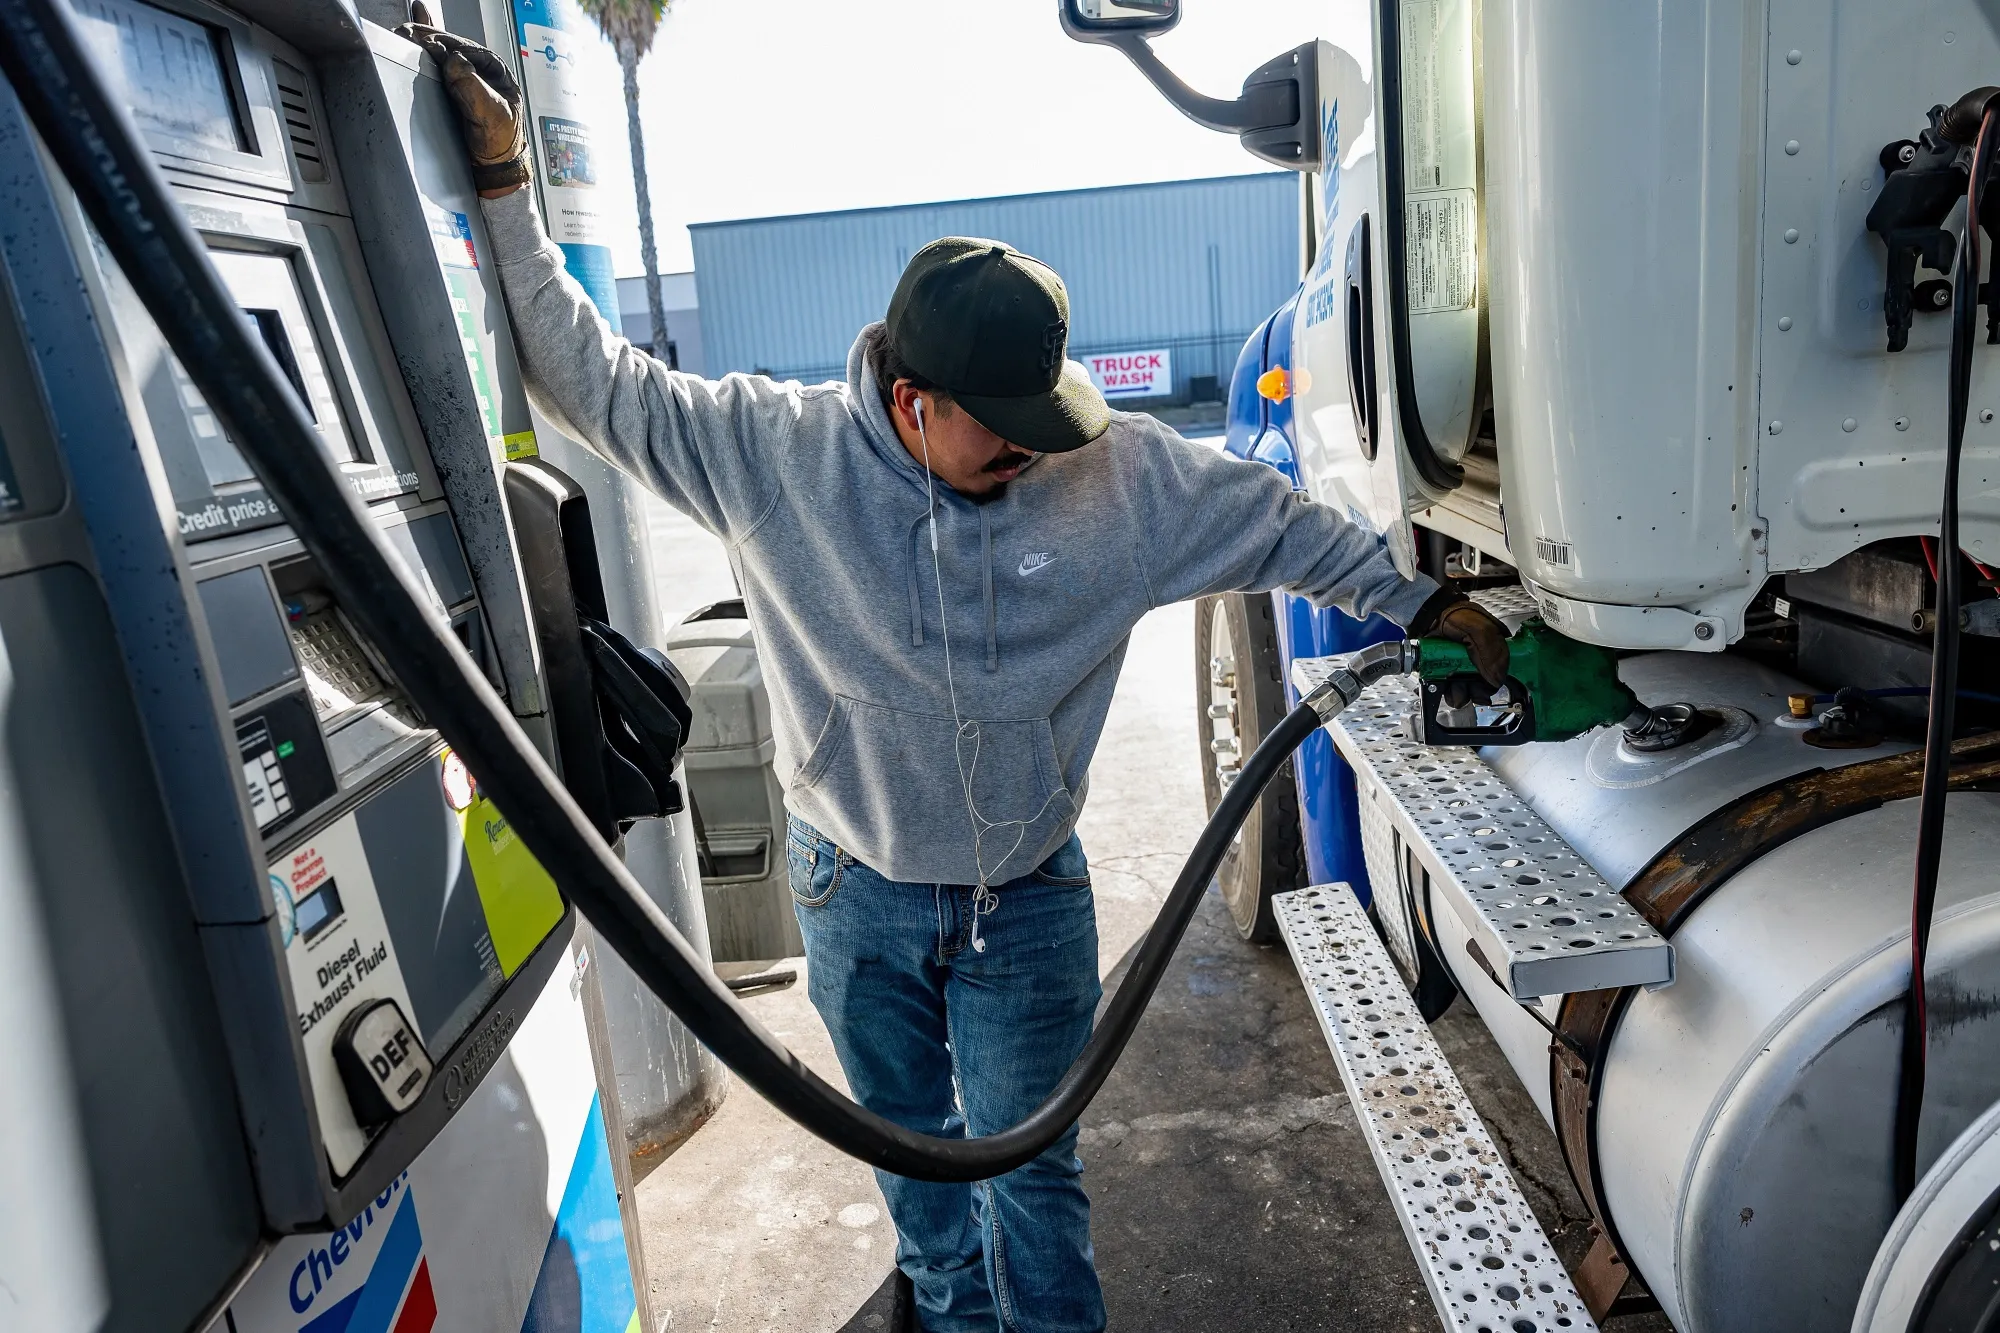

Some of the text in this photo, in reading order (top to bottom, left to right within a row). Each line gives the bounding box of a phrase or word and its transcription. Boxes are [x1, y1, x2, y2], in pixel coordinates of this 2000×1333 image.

[549, 123, 560, 132] IT'S
[561, 208, 575, 216] How
[1092, 354, 1162, 373] TRUCK
[1103, 371, 1154, 387] WASH
[361, 470, 419, 494] transactions
[176, 501, 227, 534] Credit
[229, 500, 267, 527] price
[1023, 552, 1049, 567] NIKE
[291, 856, 324, 883] Chevron
[293, 848, 316, 867] Not a
[295, 867, 327, 894] Product
[316, 938, 361, 989] Diesel
[299, 941, 388, 1037] Exhaust Fluid
[370, 1028, 410, 1083] DEF
